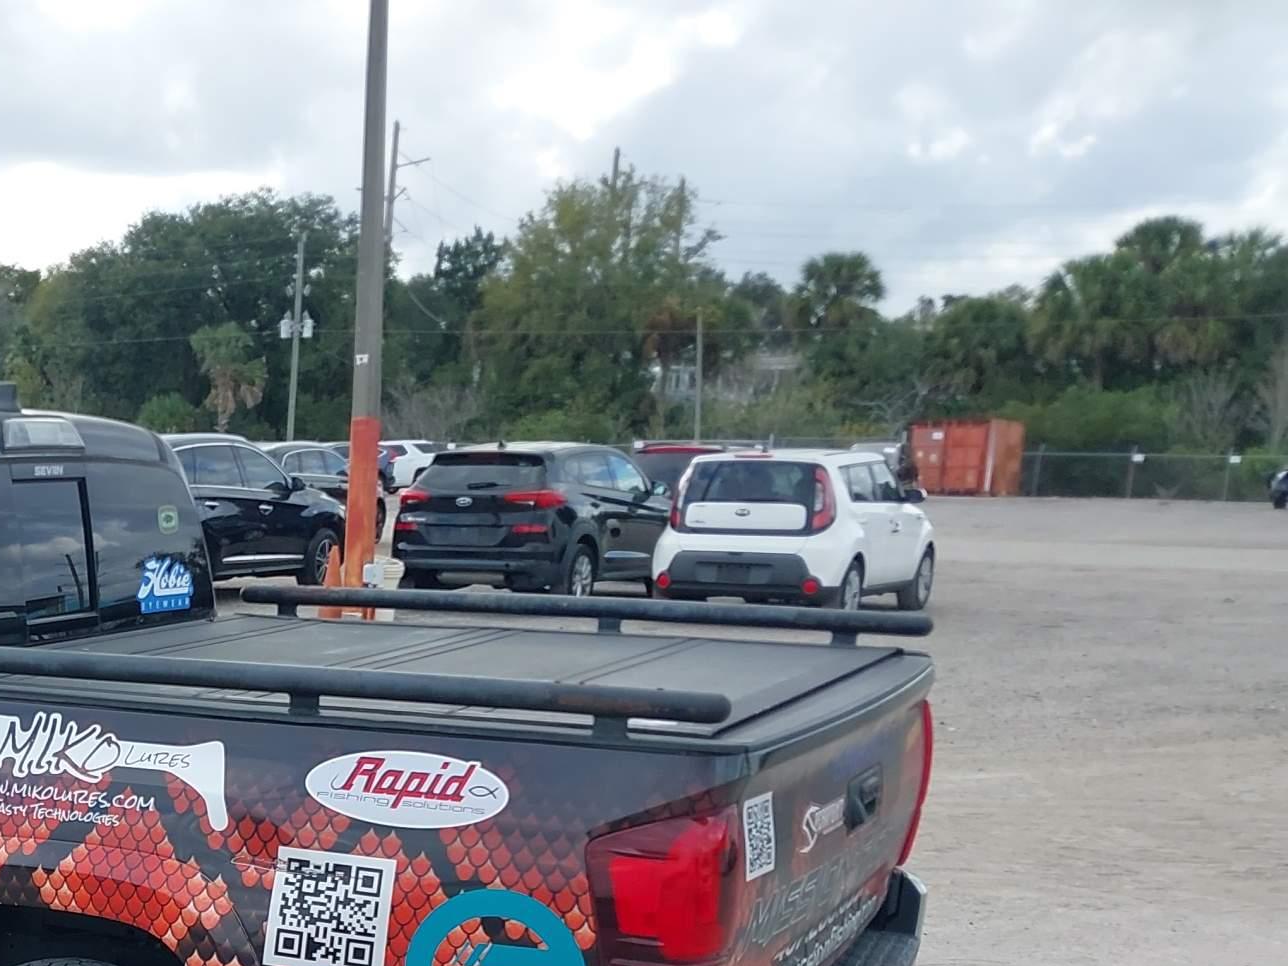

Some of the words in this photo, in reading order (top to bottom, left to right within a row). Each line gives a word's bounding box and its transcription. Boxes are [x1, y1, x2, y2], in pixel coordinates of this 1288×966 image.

[138, 557, 191, 599] Hobie
[342, 757, 476, 810] Rapid
[402, 801, 486, 816] solutions
